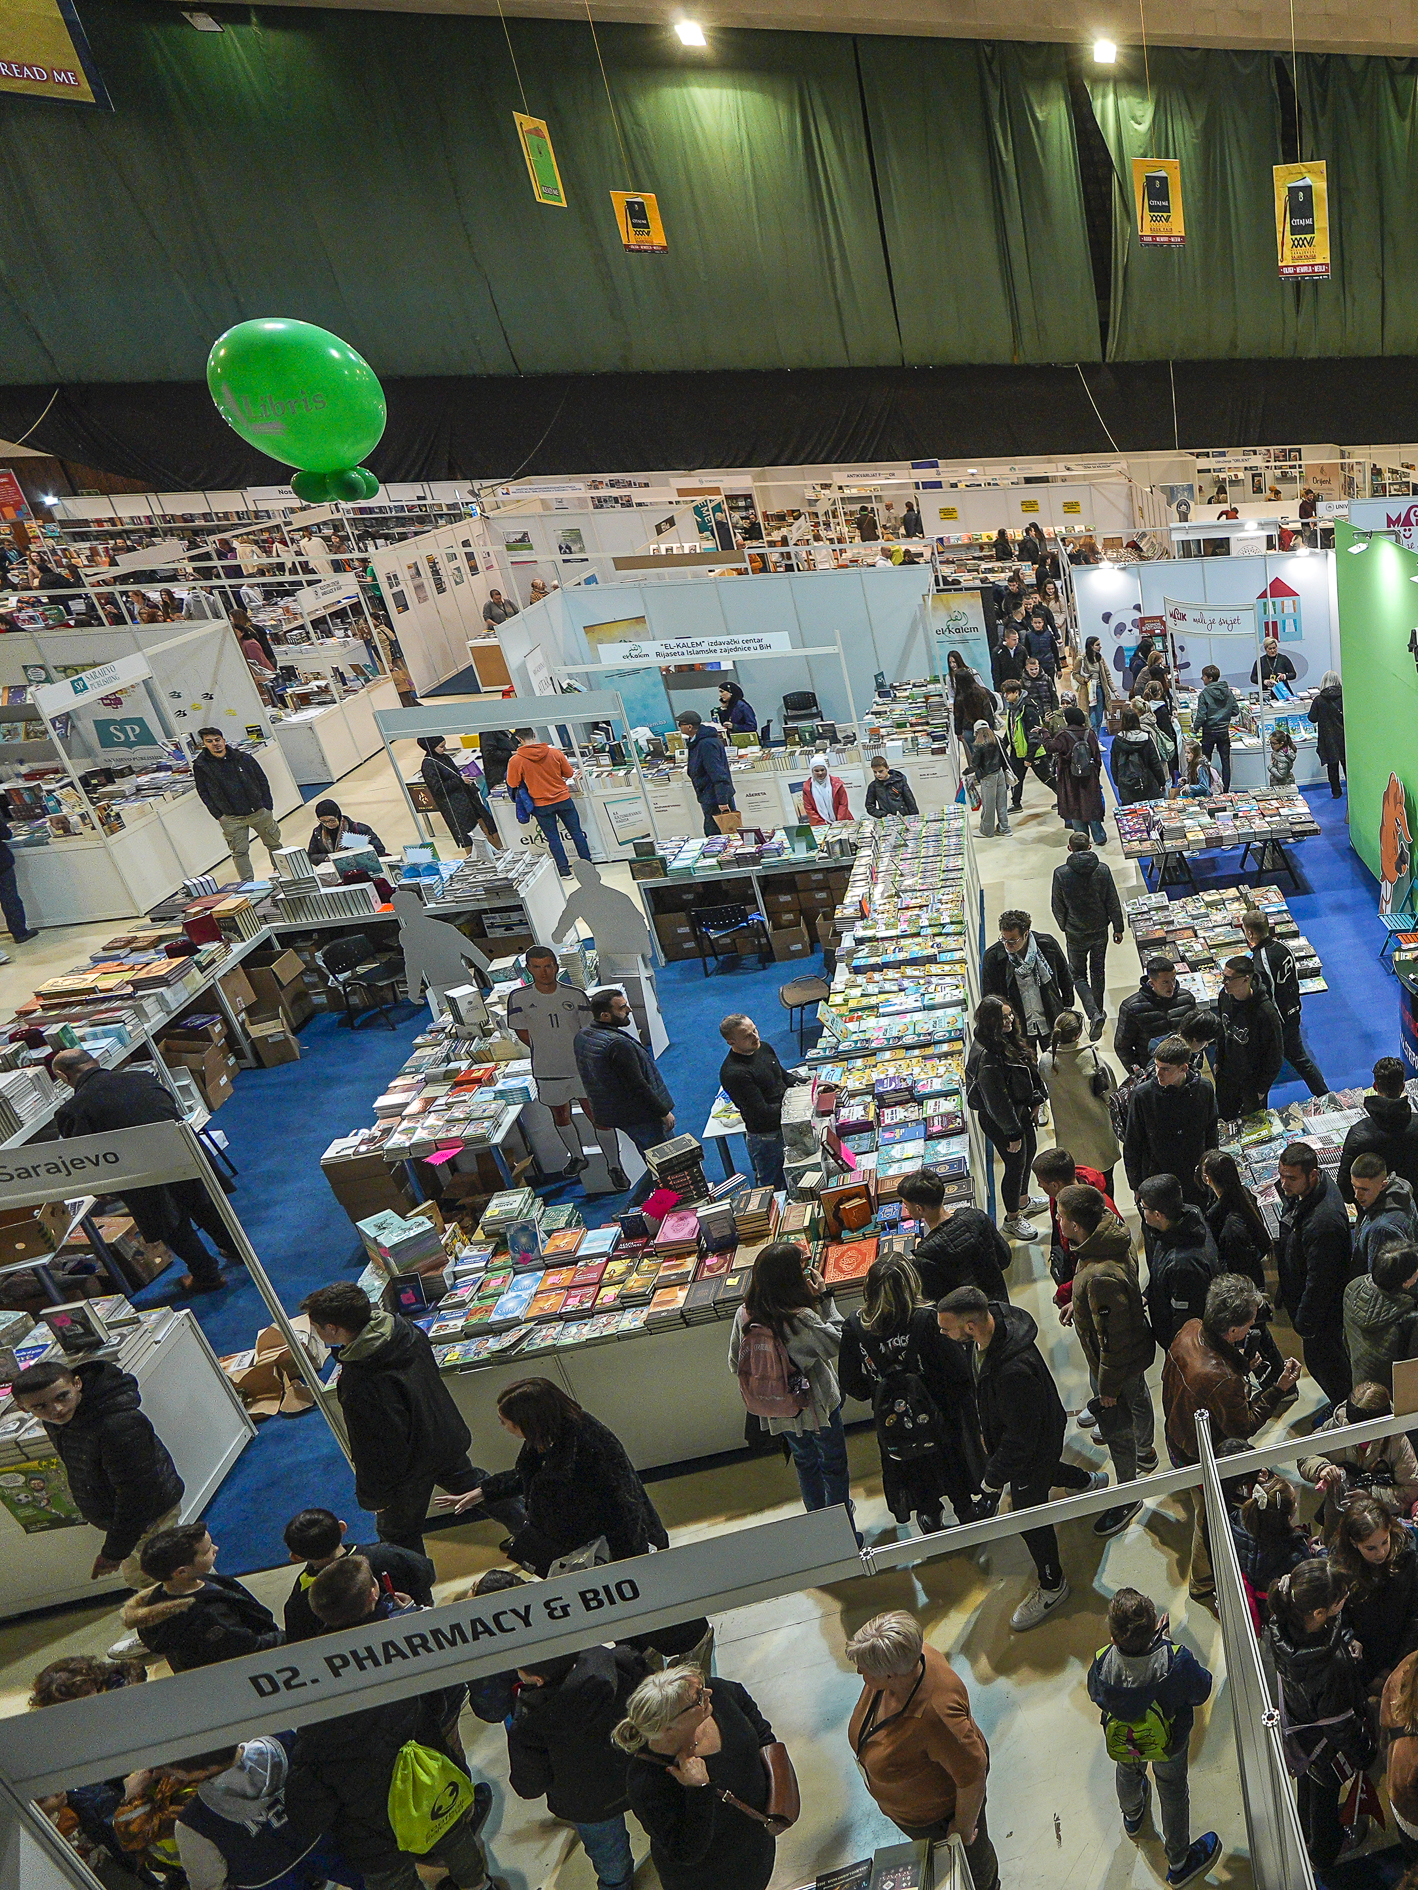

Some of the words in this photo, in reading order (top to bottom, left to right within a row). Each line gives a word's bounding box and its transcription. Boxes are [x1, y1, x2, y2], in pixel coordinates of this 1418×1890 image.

[0, 61, 49, 82] READ
[52, 68, 79, 86] ME
[1290, 216, 1306, 227] ČITAJ
[1304, 217, 1314, 226] ME
[244, 389, 328, 421] Libris
[1311, 476, 1333, 486] Orijent
[654, 649, 686, 659] Rijaseta
[685, 647, 719, 658] Islamske
[718, 645, 752, 656] zajednice
[758, 642, 772, 651] BiH
[659, 639, 706, 651] "EL-KALEM"
[705, 637, 741, 648] izdavački
[741, 636, 765, 645] centar
[85, 663, 118, 684] SARAJEVO
[88, 672, 121, 692] PUBLISHING
[73, 680, 86, 692] SP
[107, 723, 142, 744] SP
[547, 1012, 561, 1029] 11
[0, 1147, 121, 1185] Sarajevo
[247, 1664, 321, 1699] D2.
[322, 1602, 534, 1680] PHARMACY
[542, 1595, 572, 1622] &
[577, 1577, 641, 1614] BIO
